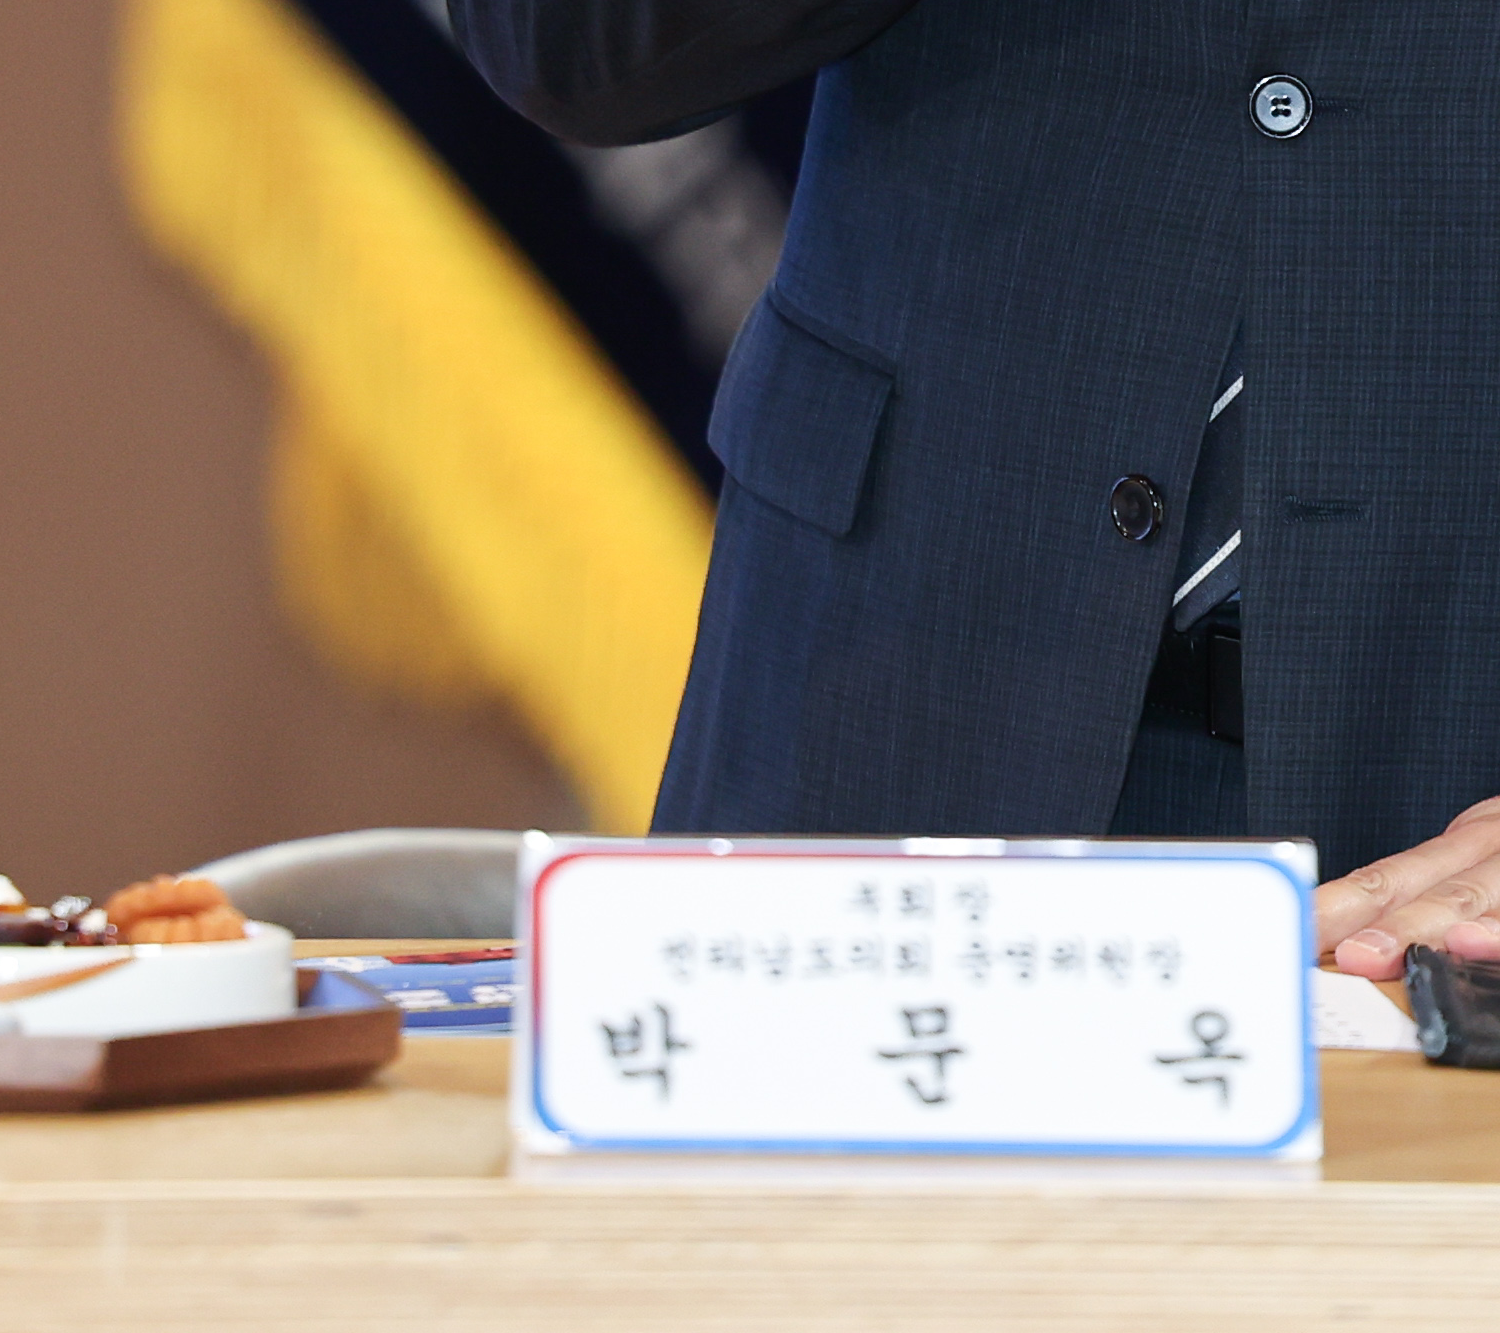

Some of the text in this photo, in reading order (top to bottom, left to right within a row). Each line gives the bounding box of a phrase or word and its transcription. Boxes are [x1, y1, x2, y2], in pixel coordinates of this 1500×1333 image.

[598, 1001, 1248, 1109] 박 문 옥
